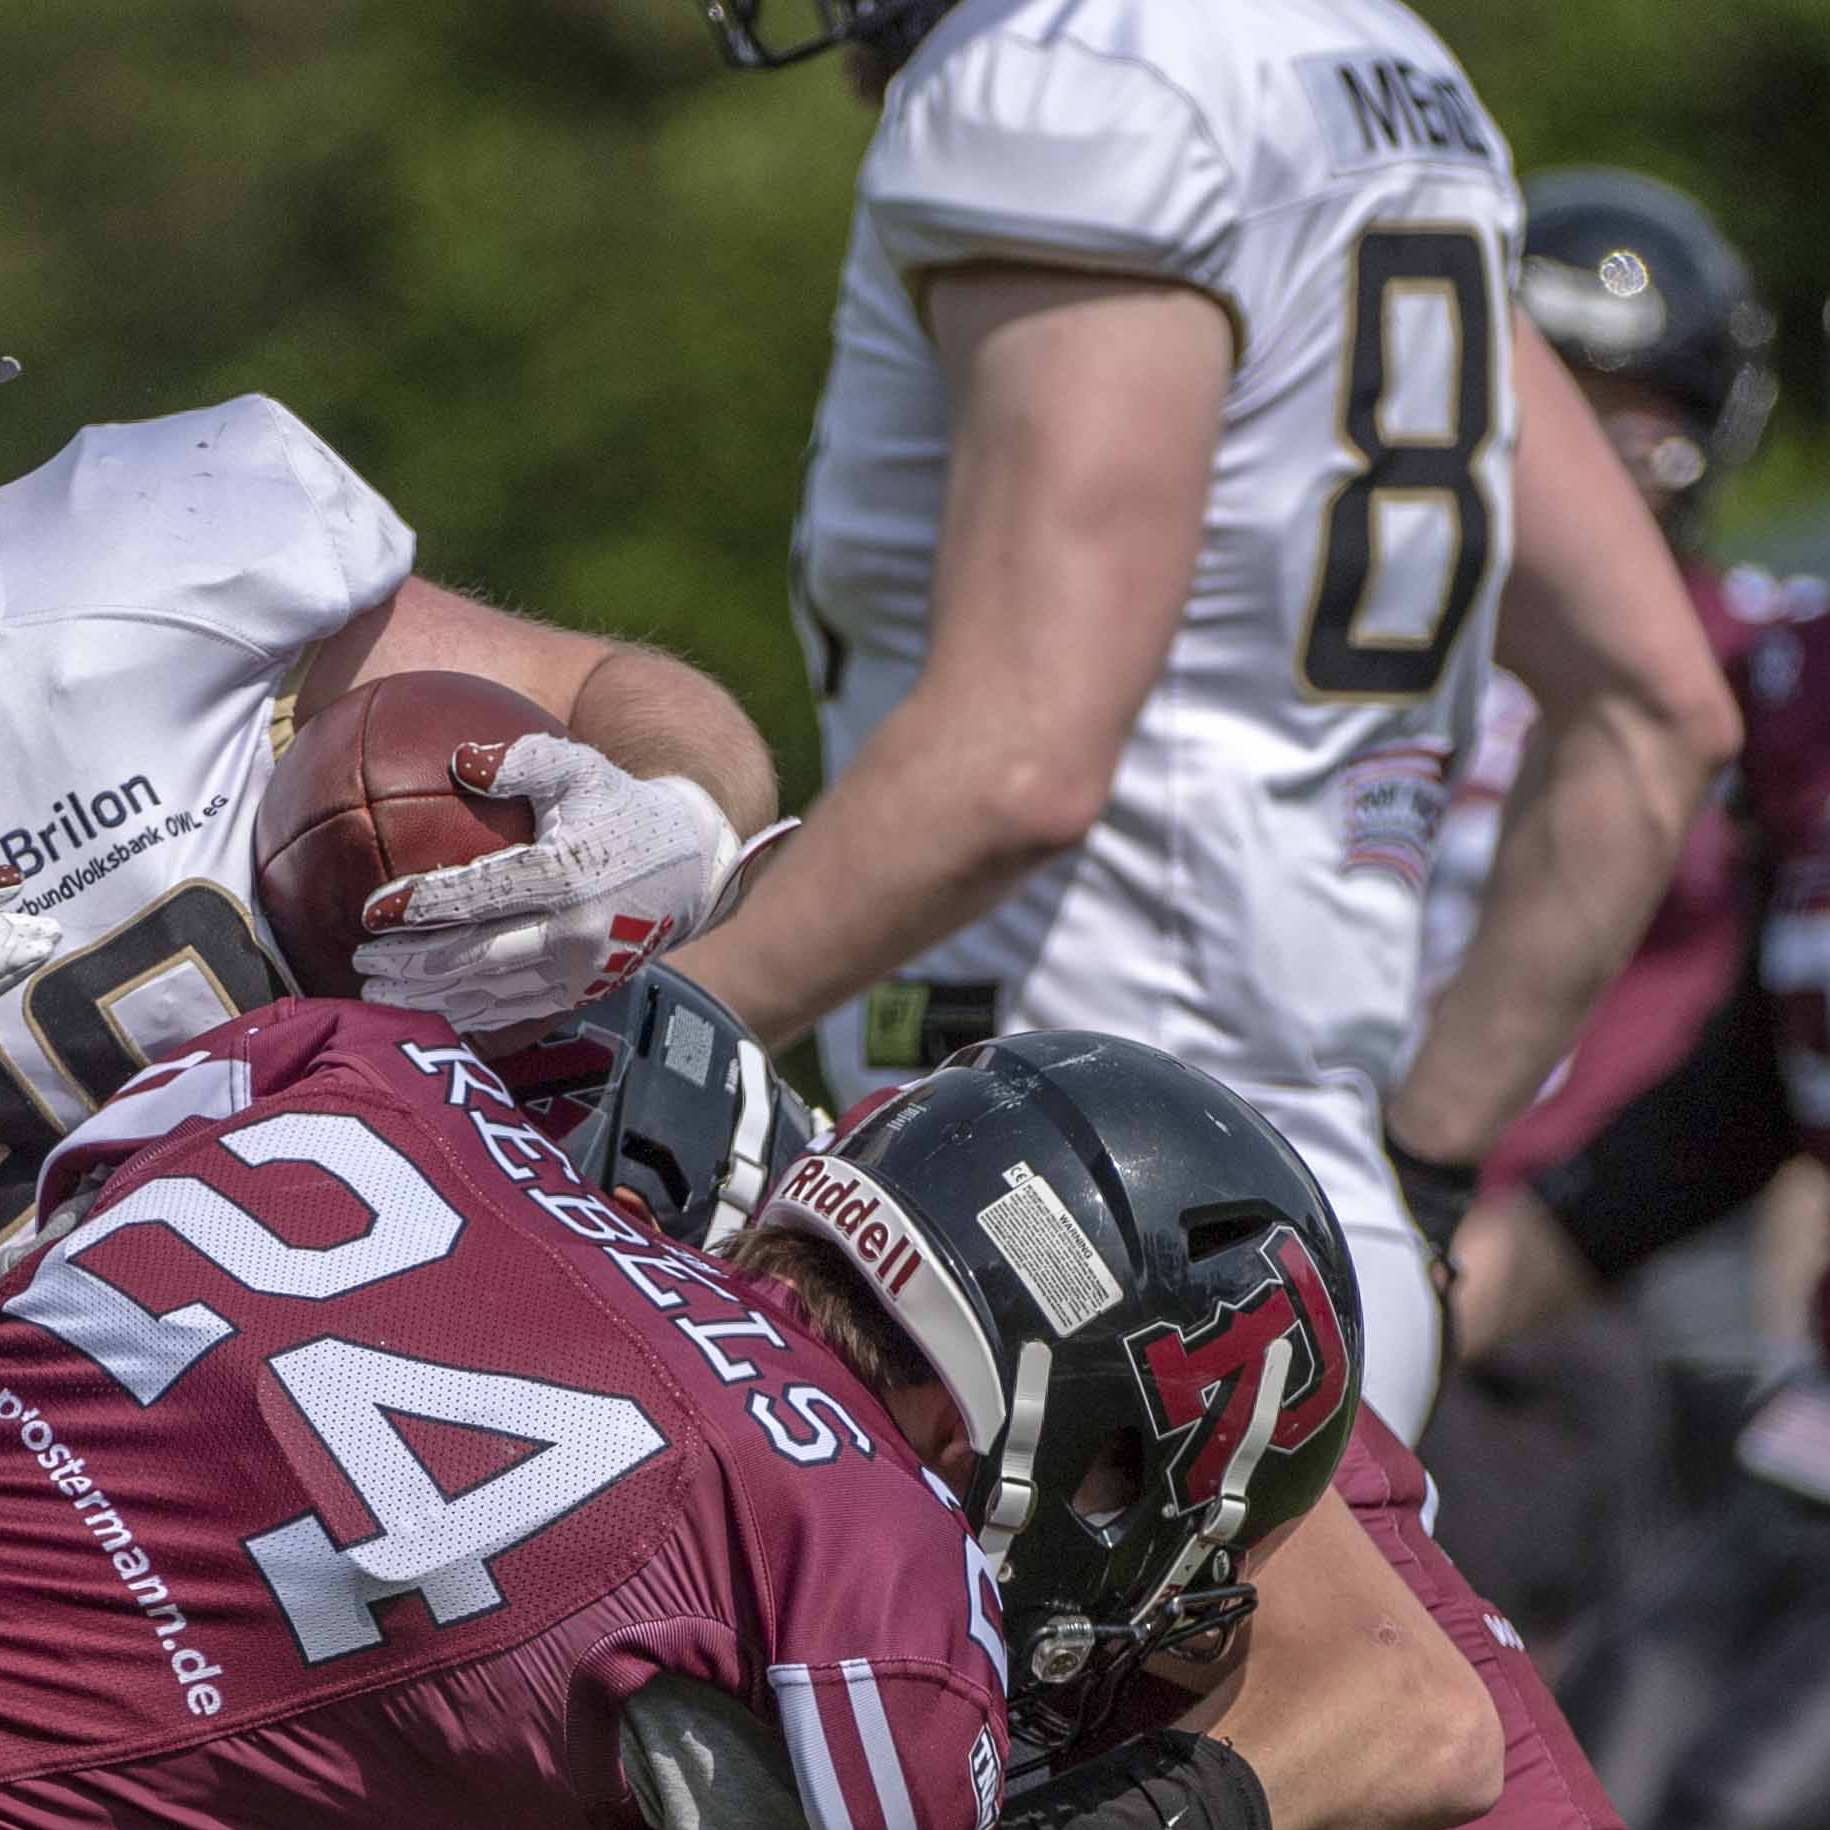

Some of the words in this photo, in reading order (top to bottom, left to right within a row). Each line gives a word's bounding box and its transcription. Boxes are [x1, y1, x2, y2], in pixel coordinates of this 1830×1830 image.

[165, 810, 203, 838] OWL
[203, 794, 229, 818] eG
[399, 1036, 877, 1468] REBELS
[779, 1158, 925, 1299] Riddell
[1058, 1212, 1094, 1260] WARNING
[1, 1109, 677, 1668] 24
